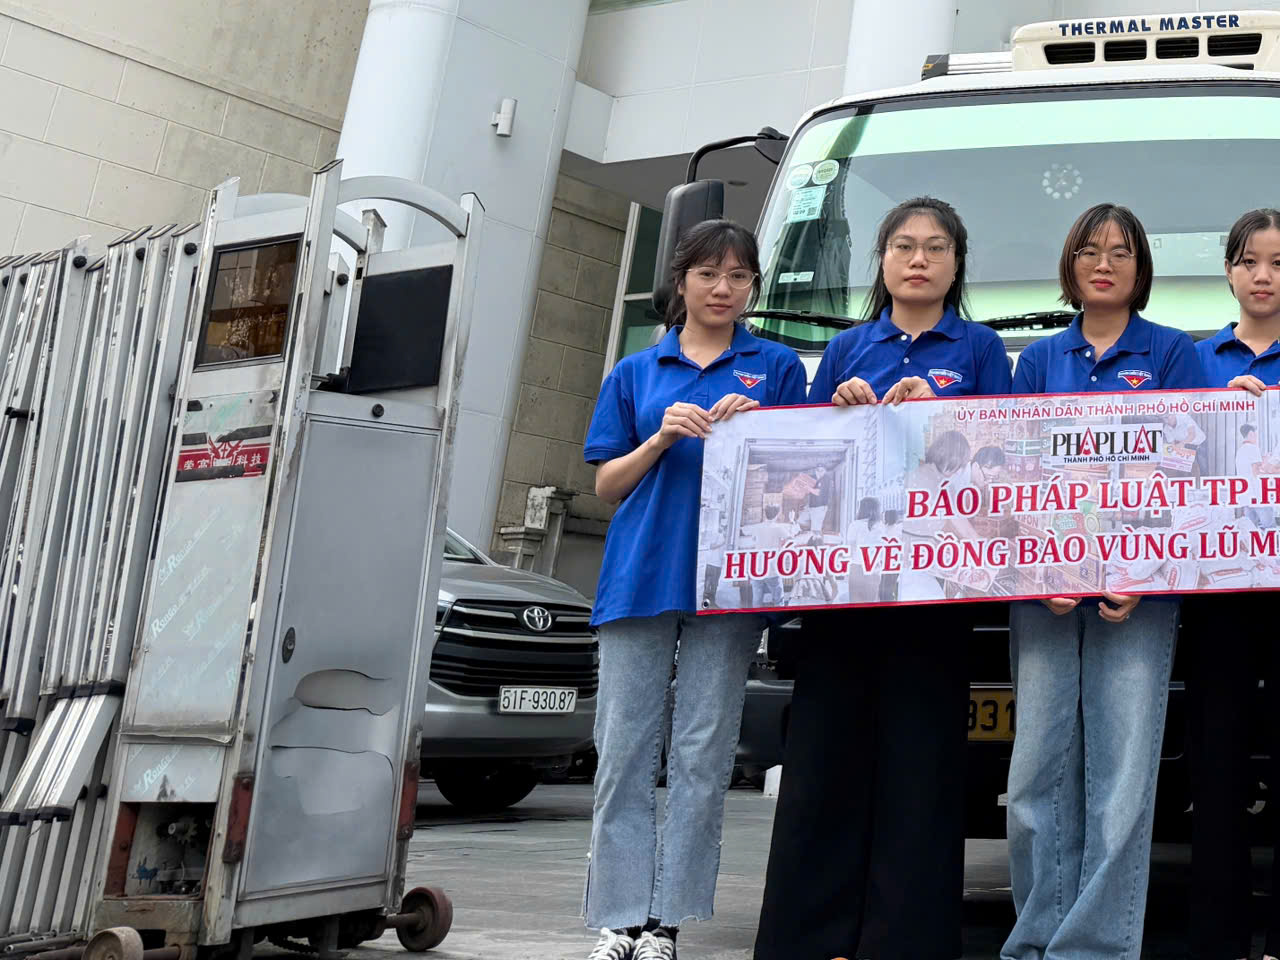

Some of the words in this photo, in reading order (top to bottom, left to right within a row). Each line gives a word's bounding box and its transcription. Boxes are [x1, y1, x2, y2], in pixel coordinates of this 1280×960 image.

[1059, 19, 1152, 36] THERMAL
[1159, 14, 1240, 31] MASTER
[979, 408, 1007, 421] BAN
[1011, 404, 1051, 420] NHÂN
[1055, 402, 1083, 417] DÂN
[1088, 401, 1132, 416] THÀNH
[1138, 399, 1168, 415] PHỐ
[1170, 399, 1189, 413] HỒ
[1192, 399, 1216, 412] CHÍ
[1219, 400, 1256, 412] MINH
[236, 452, 262, 467] 科技
[1131, 453, 1150, 462] MINH
[907, 480, 980, 519] BÁO
[990, 475, 1089, 514] PHÁP
[1099, 471, 1194, 516] LUẬT
[725, 543, 849, 579] HƯỚNG
[860, 536, 903, 573] VỀ
[911, 532, 1008, 570] ĐỒNG
[1017, 529, 1087, 565] BÀO
[1096, 526, 1190, 561] VÙNG
[1199, 524, 1240, 558] LŨ
[502, 690, 575, 710] 51F-930.87
